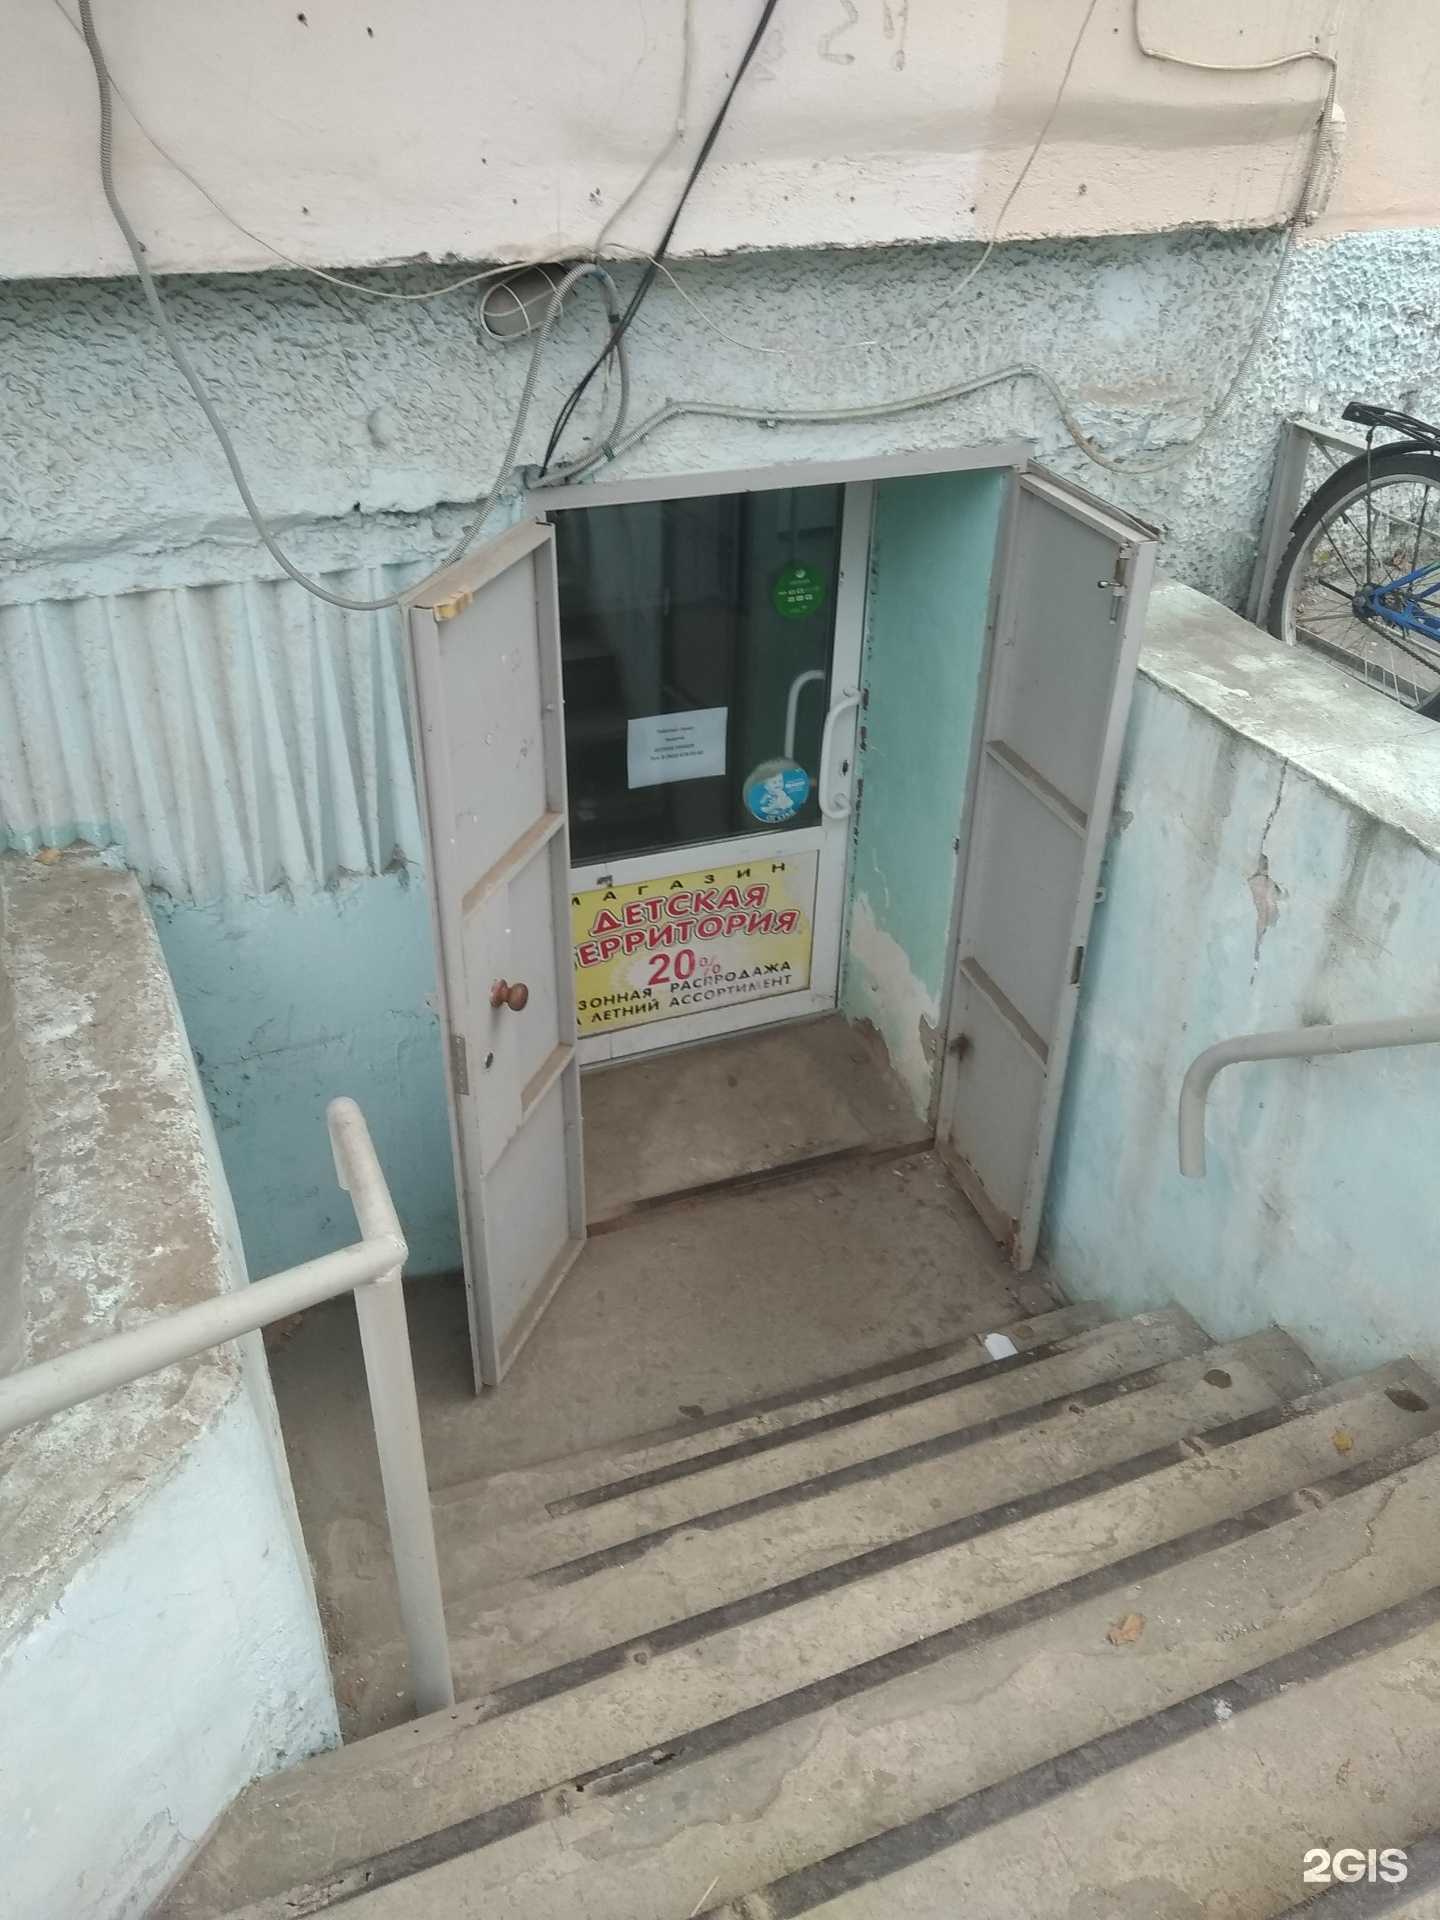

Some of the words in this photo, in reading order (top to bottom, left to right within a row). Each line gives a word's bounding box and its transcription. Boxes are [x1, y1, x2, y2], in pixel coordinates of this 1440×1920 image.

[590, 885, 768, 936] ДЕТСКАЯ
[574, 910, 800, 969] ЕРРИТОРИЯ
[577, 987, 653, 1011] ЗОННАЯ
[669, 960, 792, 993] РАСПРОДАЖА
[647, 948, 722, 986] 20%
[591, 998, 659, 1023] ЛЕТНИЙ
